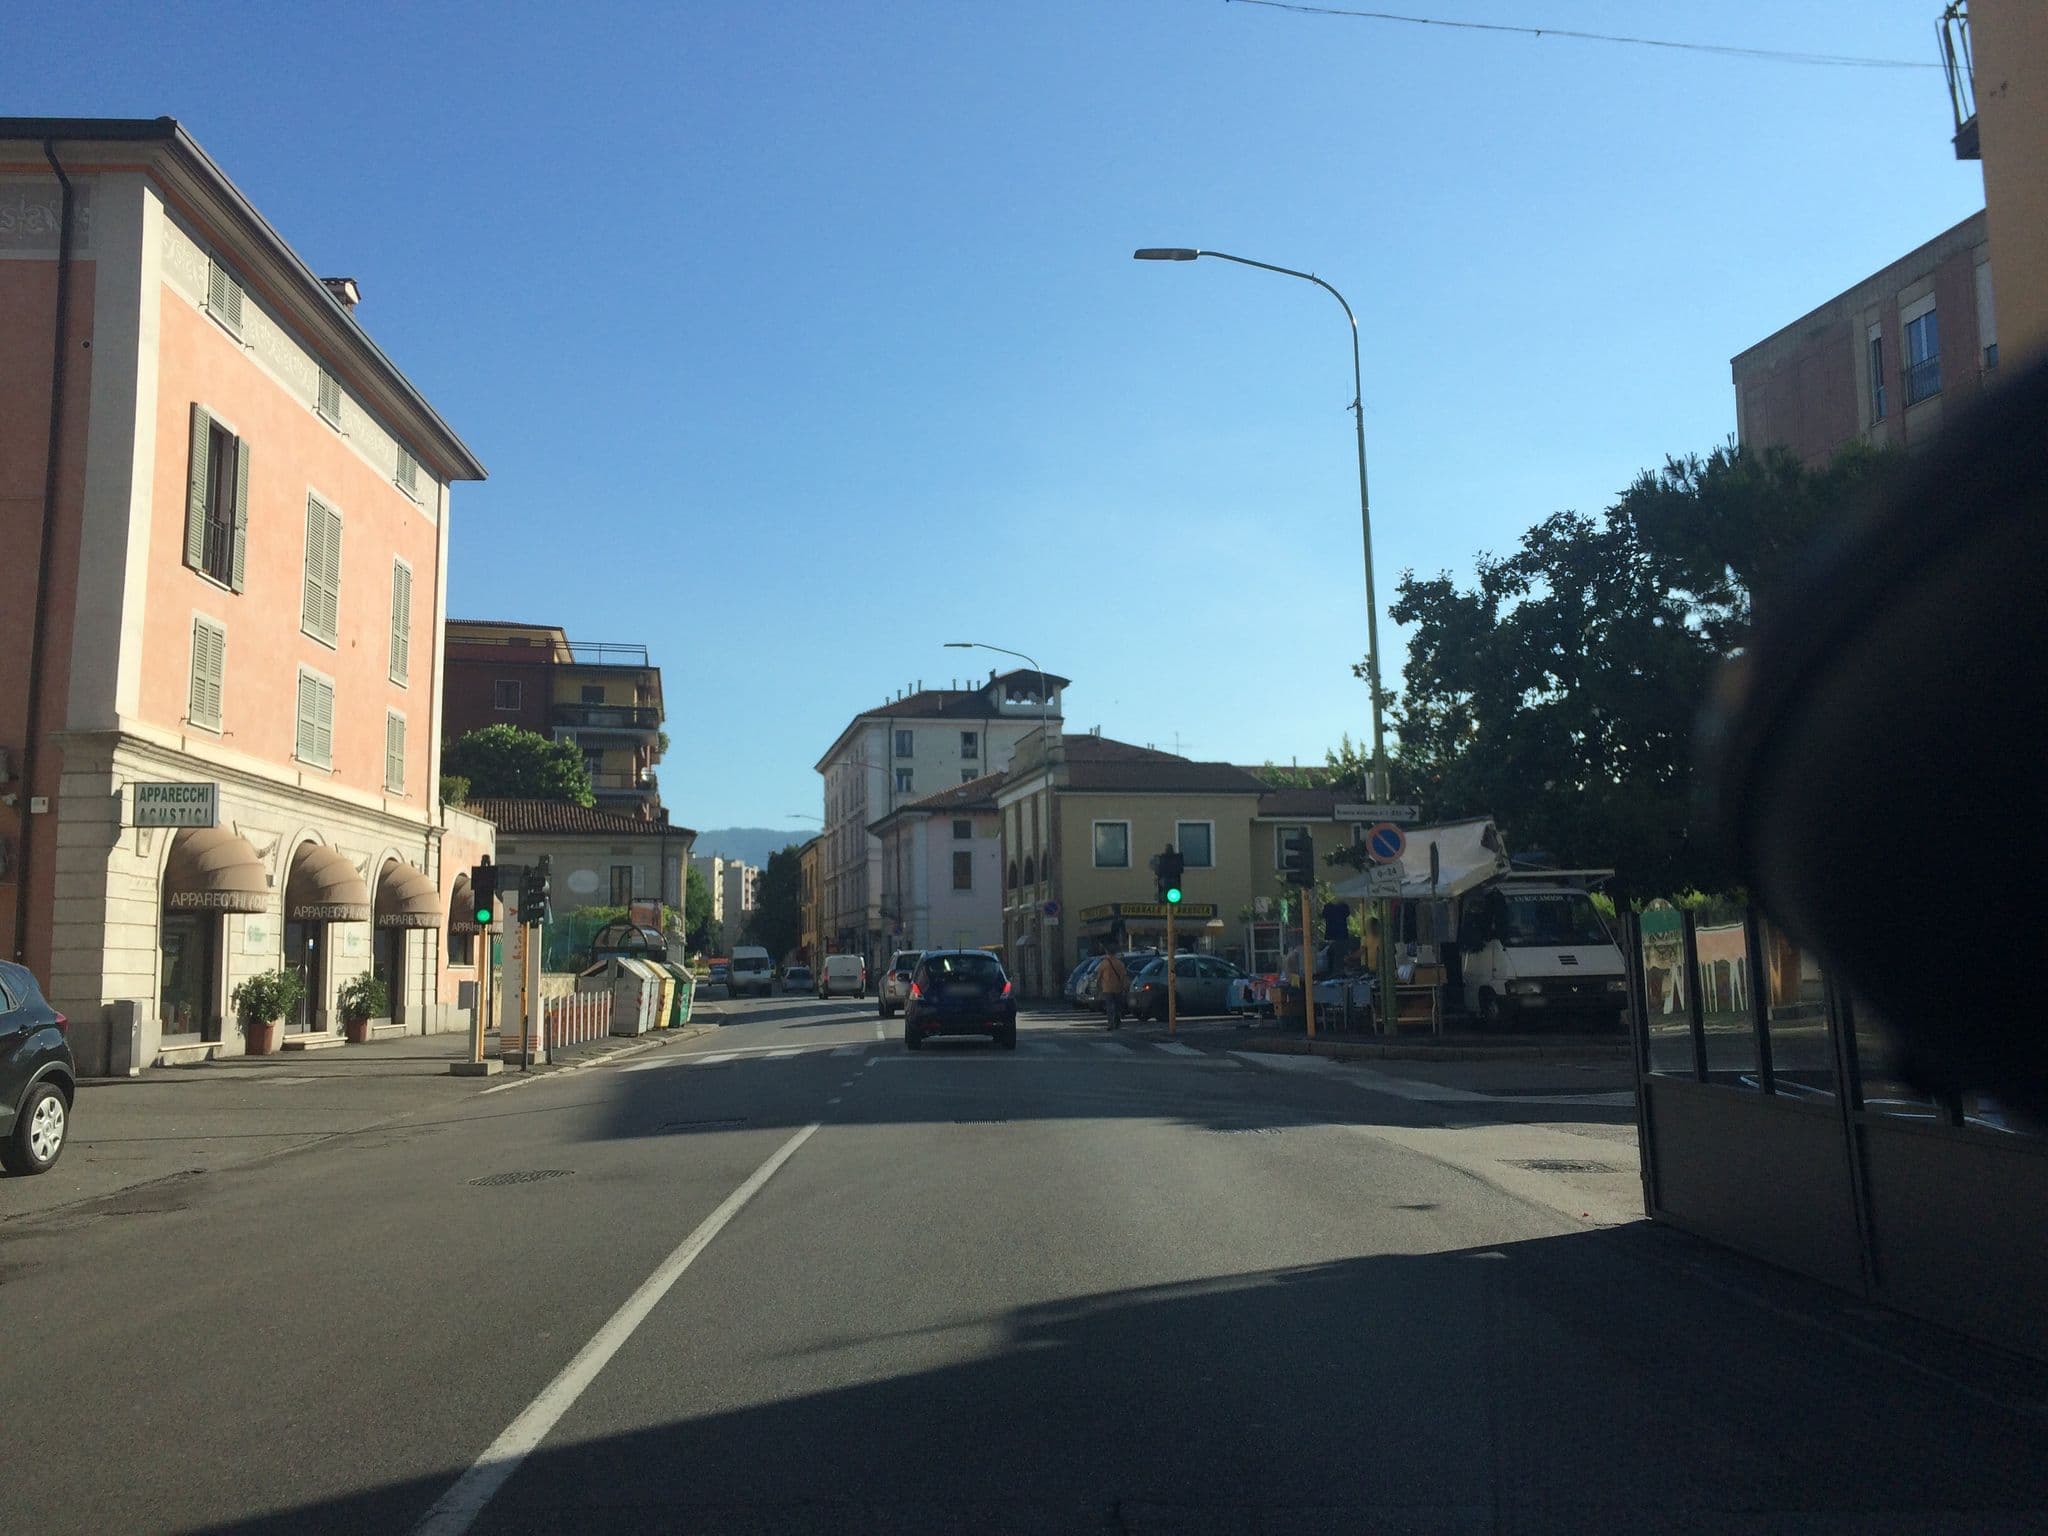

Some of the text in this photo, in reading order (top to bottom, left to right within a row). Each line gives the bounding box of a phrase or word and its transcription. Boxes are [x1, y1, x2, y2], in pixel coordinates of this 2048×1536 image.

[139, 787, 208, 802] APPARECCHI
[140, 808, 208, 823] ACUSTICI
[170, 892, 245, 908] APPARECCHI
